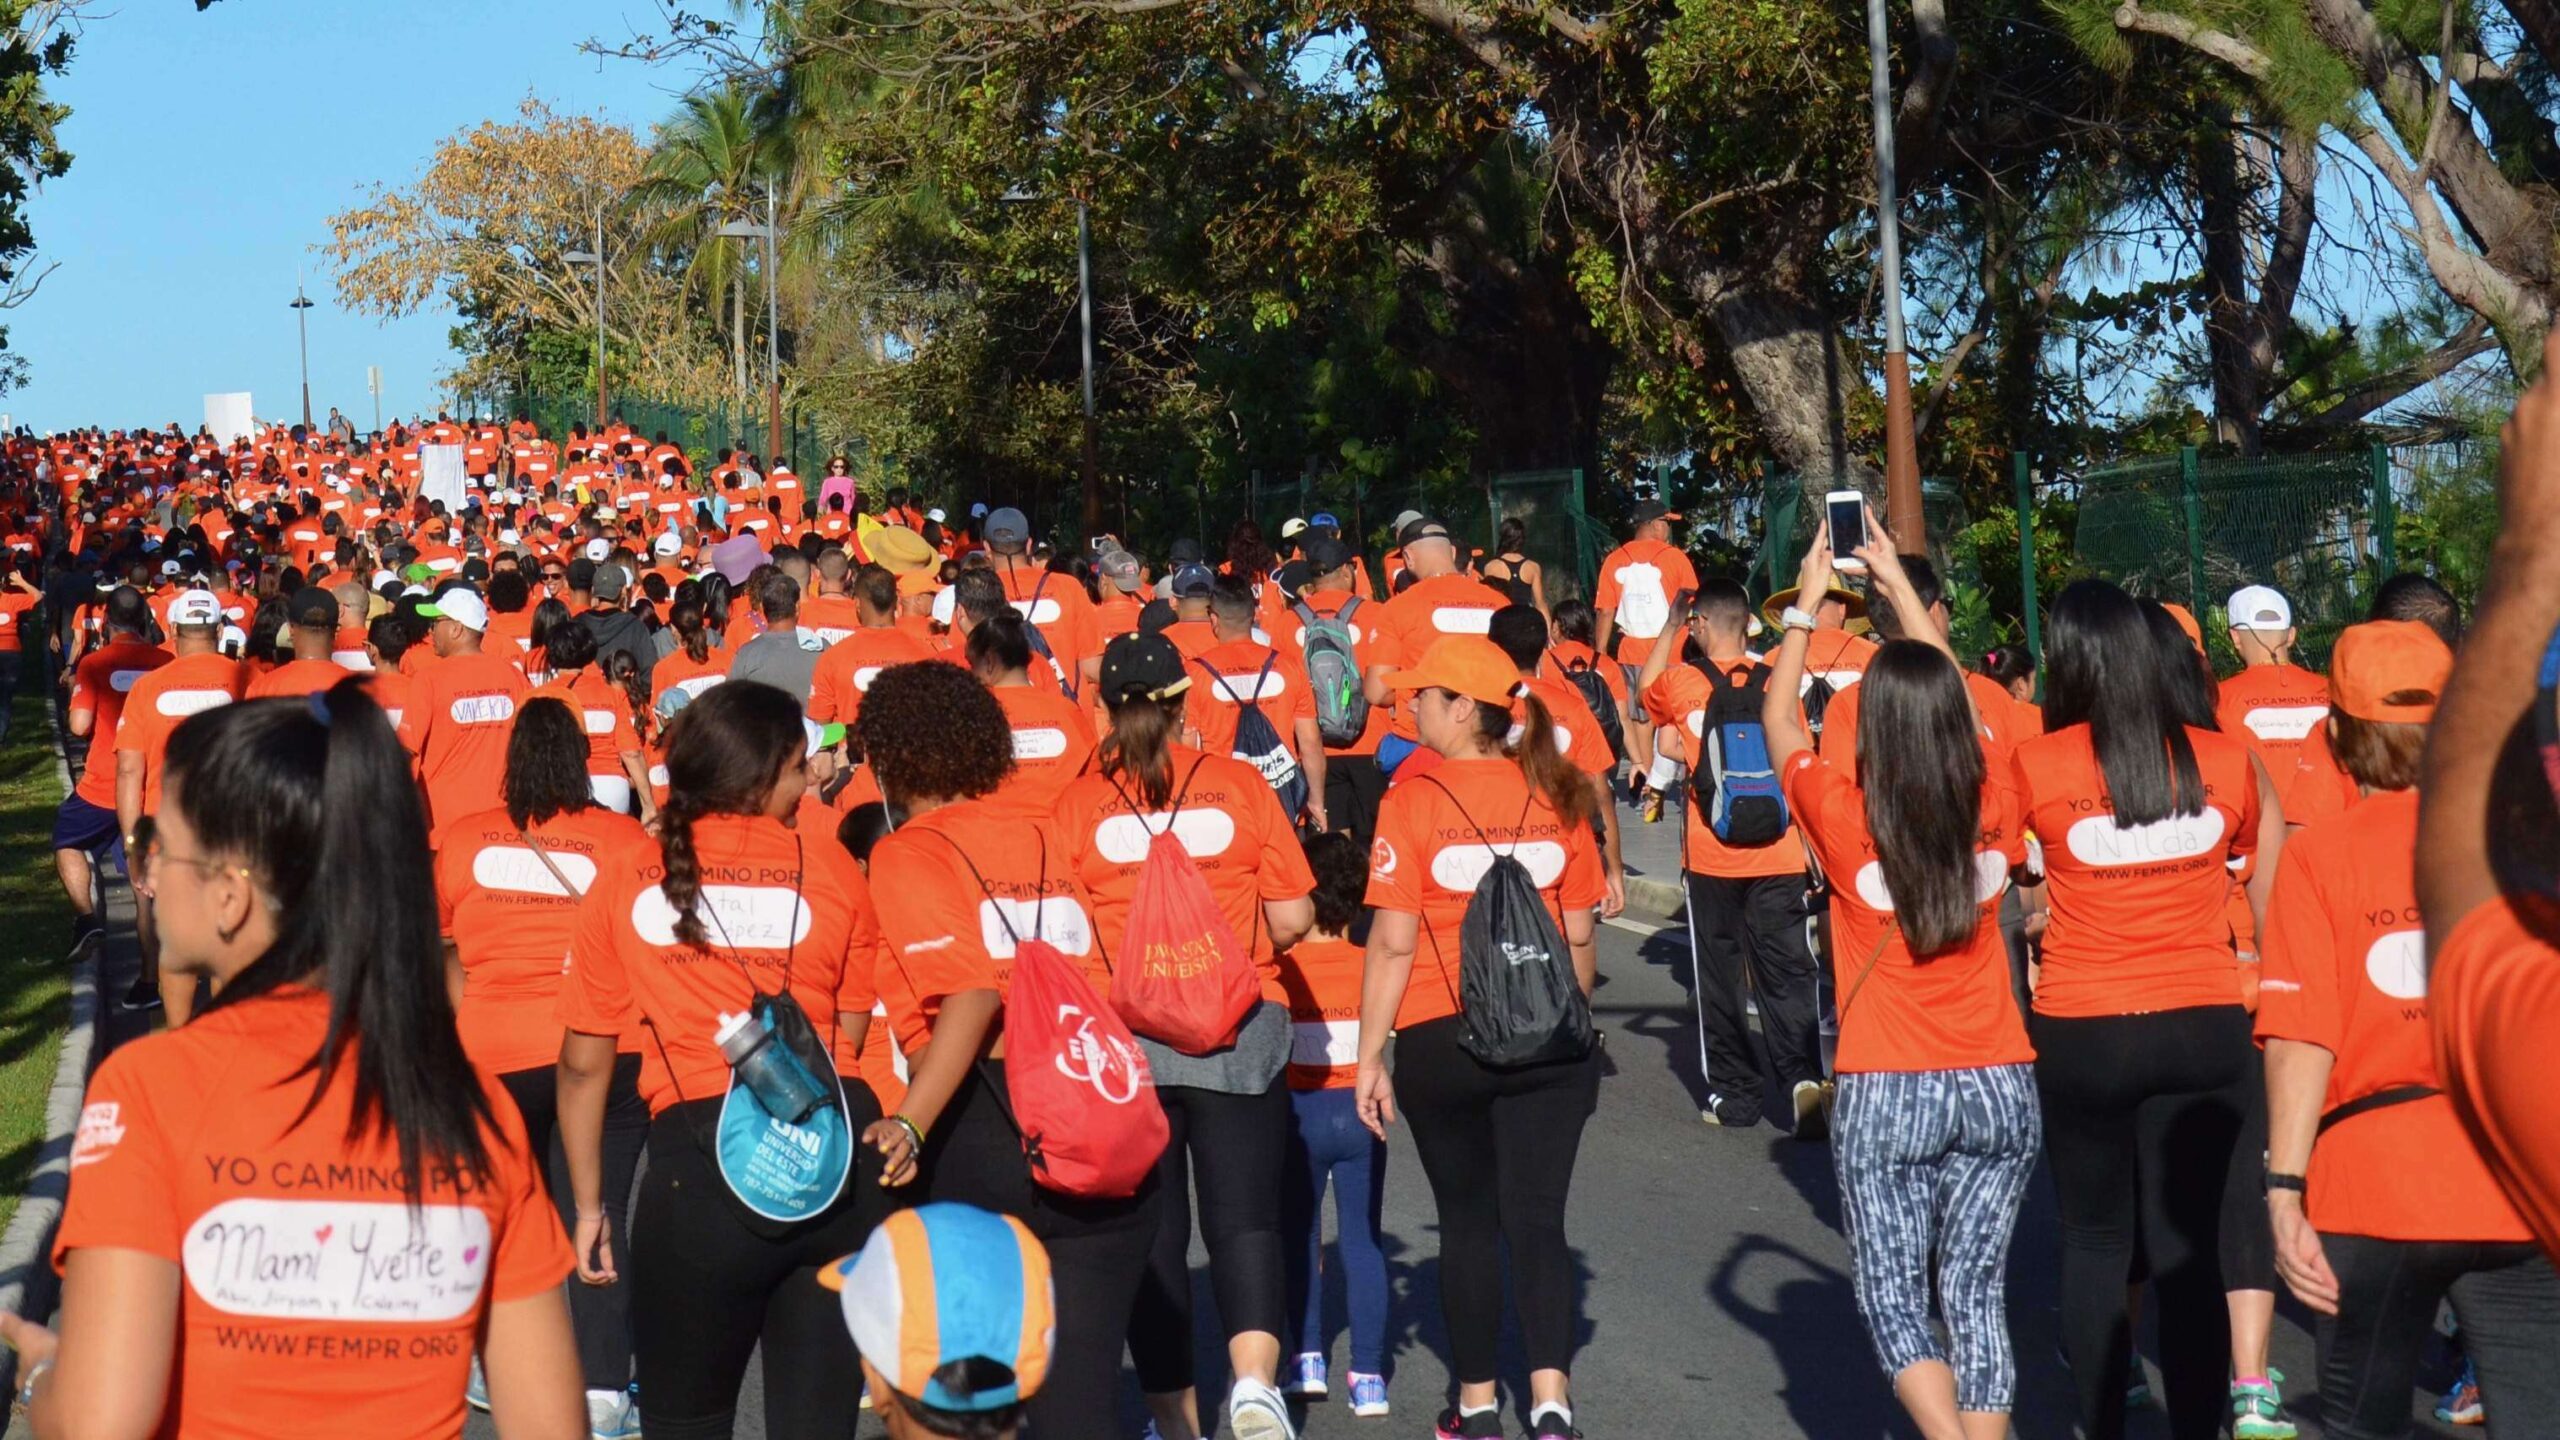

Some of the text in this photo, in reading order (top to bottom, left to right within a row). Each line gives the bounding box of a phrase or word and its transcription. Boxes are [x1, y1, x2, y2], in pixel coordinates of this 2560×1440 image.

[2244, 697, 2260, 706] YO
[2262, 696, 2308, 705] CAMINO
[1098, 801, 1118, 815] YO
[1194, 791, 1226, 804] POR
[2068, 798, 2093, 812] YO
[1437, 828, 1458, 840] YO
[1530, 823, 1560, 836] POR
[481, 831, 500, 842] YO
[565, 839, 595, 854] POR
[637, 866, 803, 884] YO MINO POR
[2365, 908, 2396, 928] YO
[205, 1155, 257, 1186] YO
[271, 1161, 411, 1194] CAMINO
[203, 1219, 446, 1305] Mami Yvette
